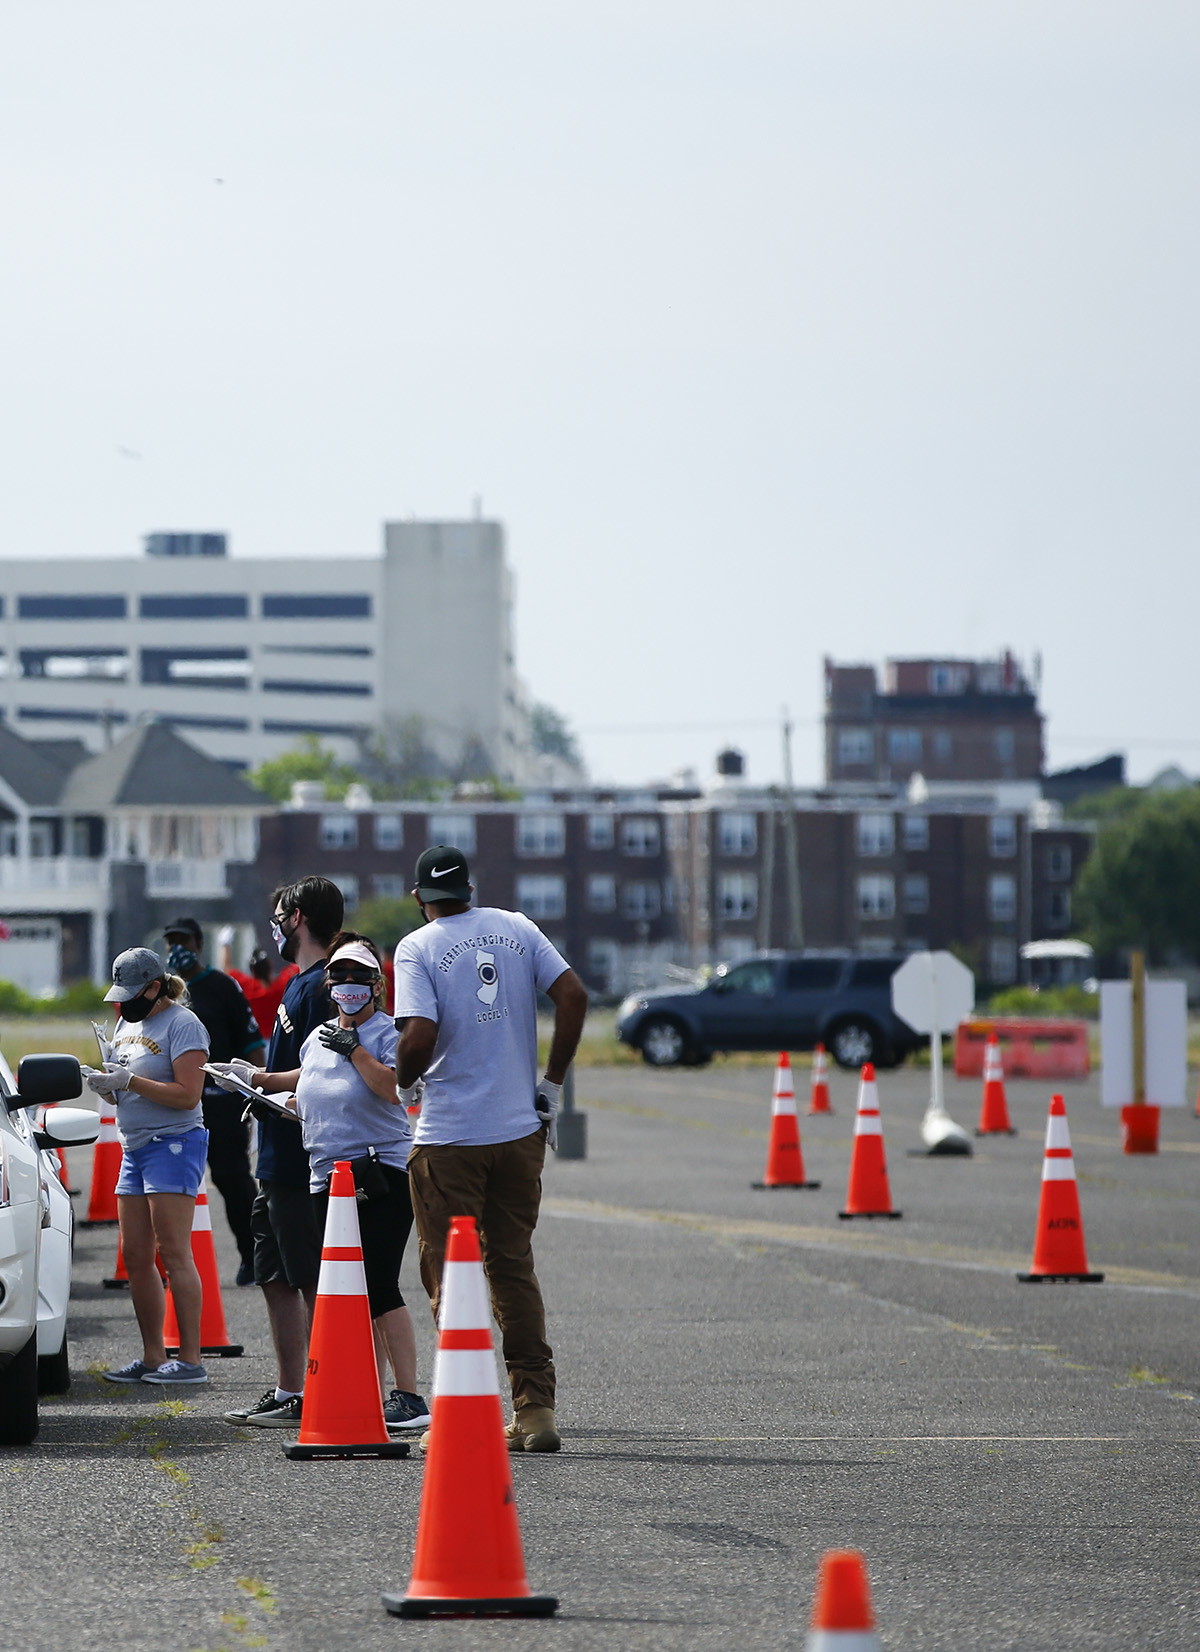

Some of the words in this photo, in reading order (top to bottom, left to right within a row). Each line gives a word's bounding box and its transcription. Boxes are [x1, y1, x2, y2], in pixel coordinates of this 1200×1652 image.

[438, 938, 476, 973] OPERATING
[476, 934, 526, 956] ENGINEERS
[476, 1009, 501, 1023] LOCAL
